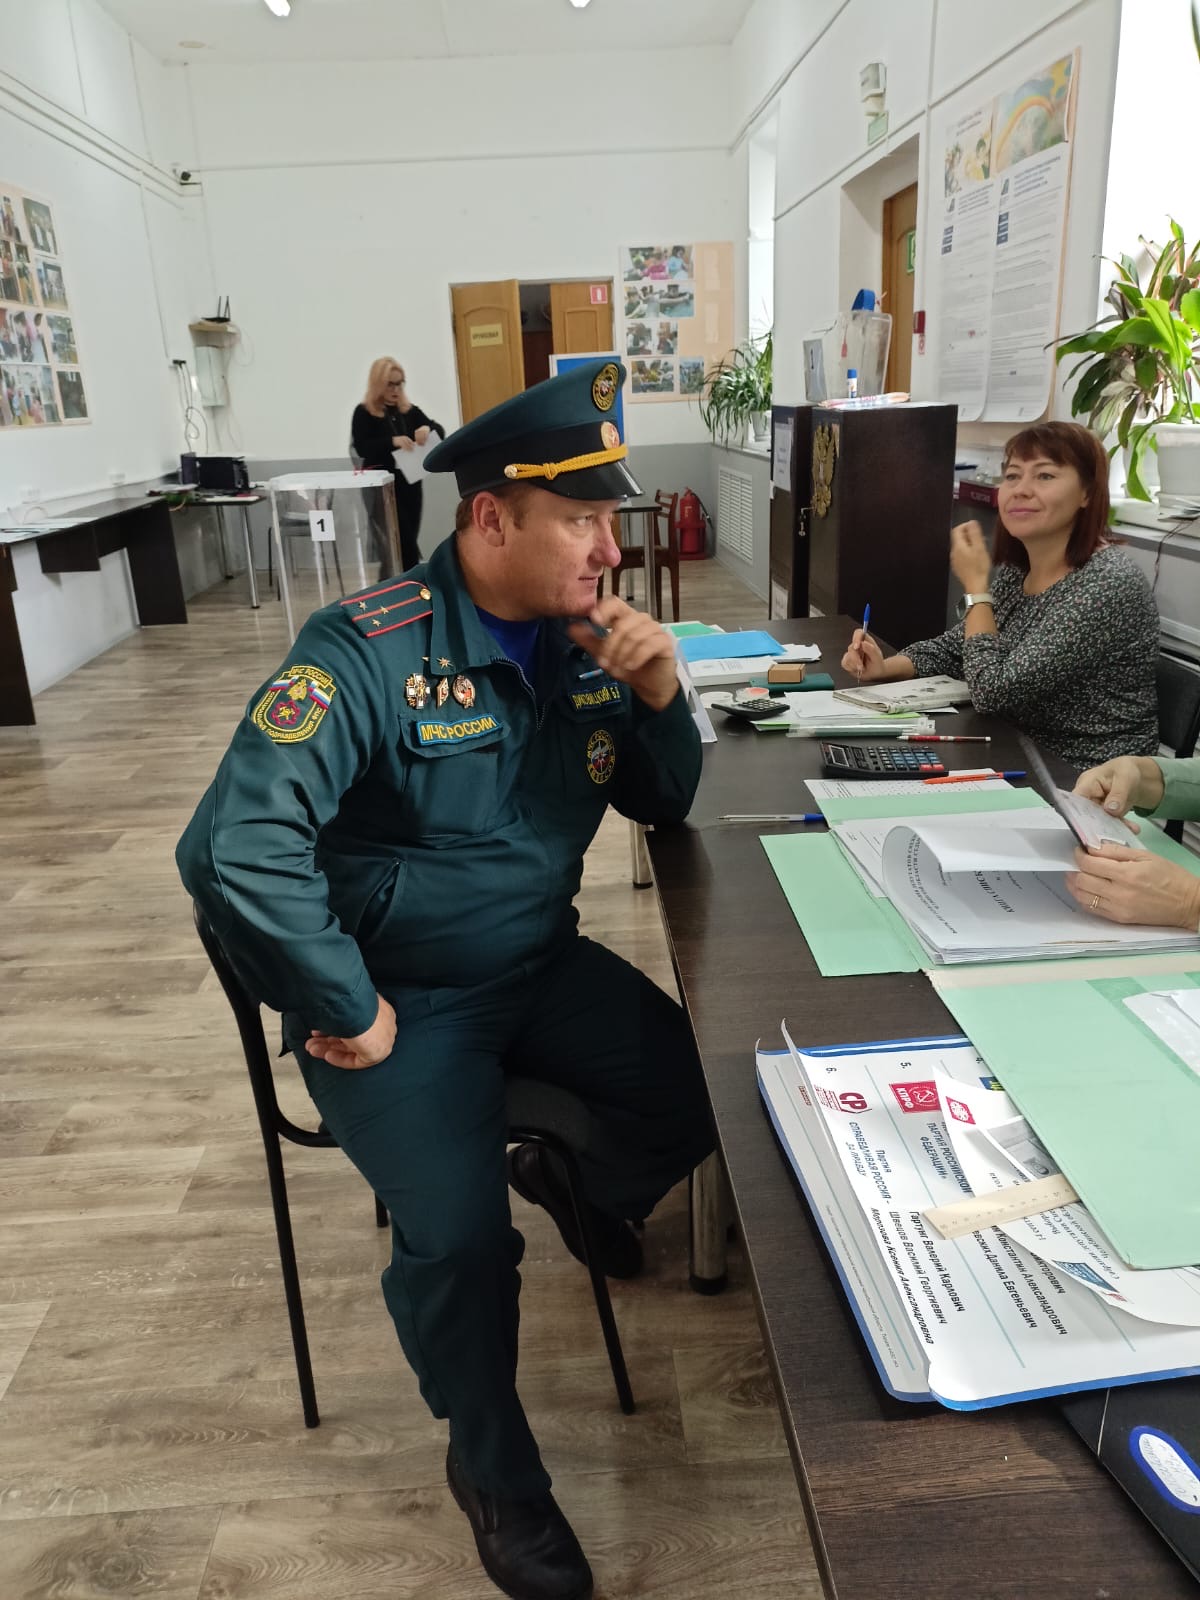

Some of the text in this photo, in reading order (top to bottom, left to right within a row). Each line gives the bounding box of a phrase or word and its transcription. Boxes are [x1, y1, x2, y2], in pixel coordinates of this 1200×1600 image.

[316, 518, 325, 532] 1
[420, 715, 497, 741] МЧС РОССИИ
[825, 1066, 837, 1074] 6.
[900, 1061, 911, 1069] 5.
[838, 1092, 868, 1110] СР
[896, 1087, 914, 1109] КПРФ
[926, 1122, 946, 1147] ПАРТИЯ
[849, 1121, 880, 1172] СПРАВЕДЛИВАЯ
[871, 1170, 892, 1200] РОССИЯ
[875, 1149, 892, 1173] Партия
[888, 1211, 948, 1325] Швецов Василий Георгиевич
[909, 1211, 965, 1312] Гартунг Валерий Карлович
[870, 1207, 934, 1345] Морозова Ксения Александровна
[996, 1230, 1029, 1276] Константин
[1021, 1273, 1068, 1336] Александрович
[985, 1252, 1009, 1281] Данила
[1002, 1280, 1038, 1329] Евгеньевич
